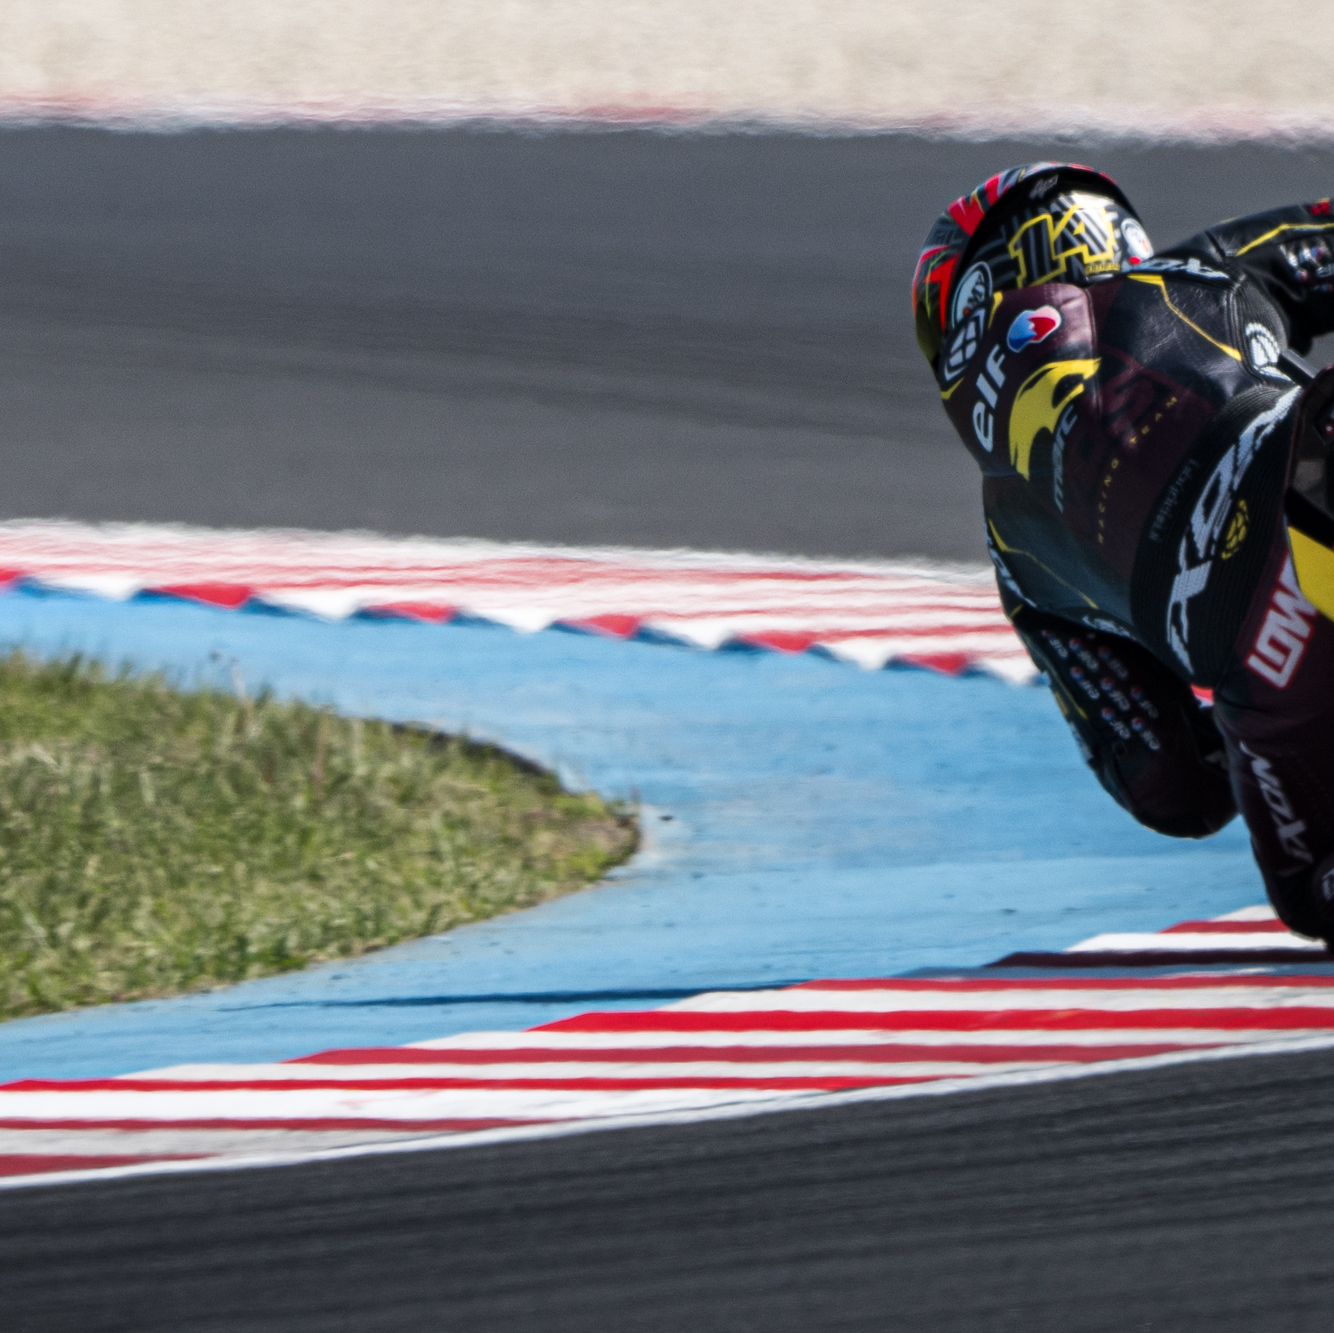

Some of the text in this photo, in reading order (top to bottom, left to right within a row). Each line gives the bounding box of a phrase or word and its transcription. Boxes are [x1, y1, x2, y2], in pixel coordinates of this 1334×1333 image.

[971, 343, 1008, 453] elf
[1054, 404, 1078, 513] marc
[1097, 459, 1120, 545] RACING
[1128, 396, 1179, 450] TEAM
[1246, 554, 1319, 688] LOW
